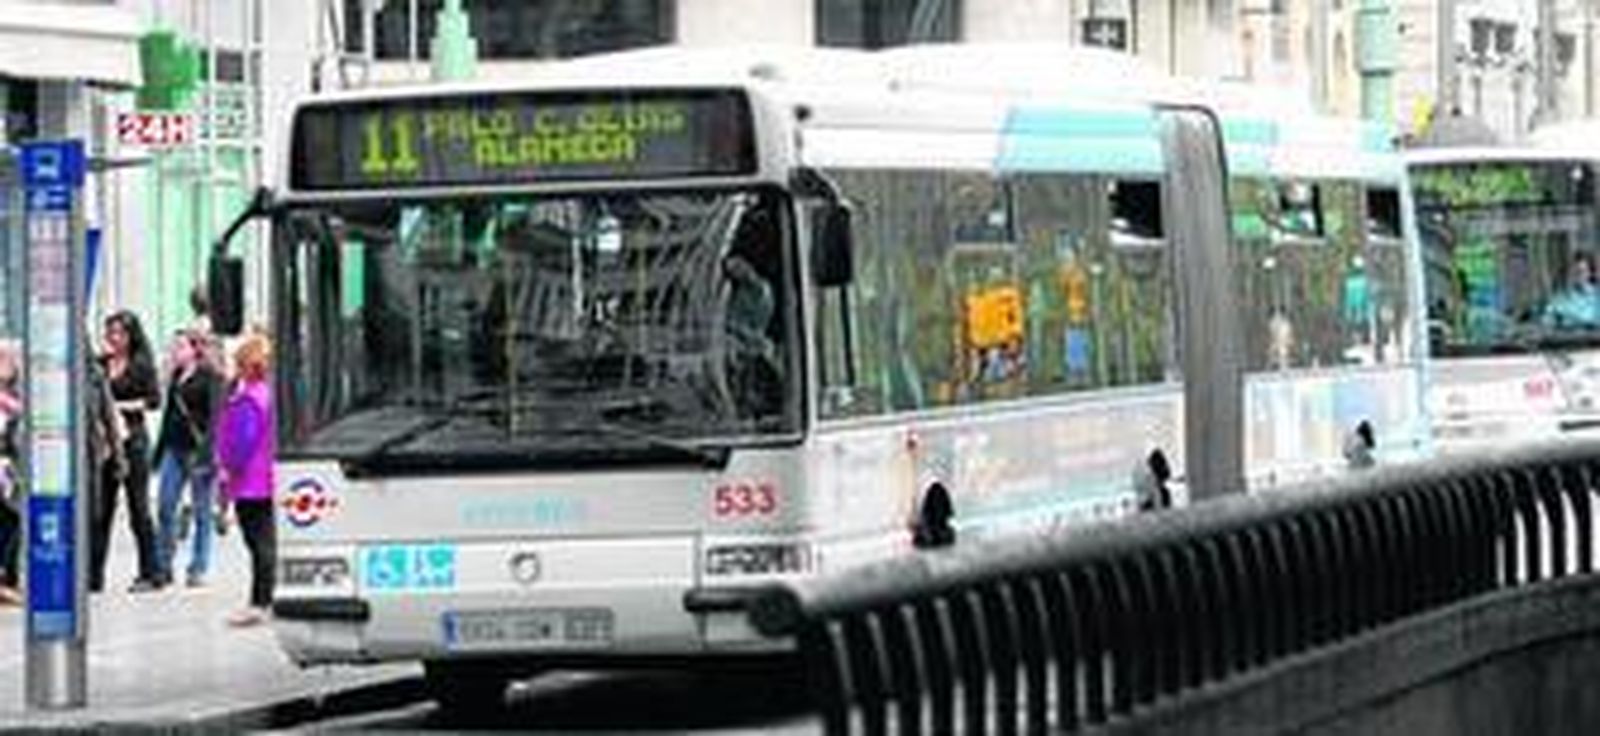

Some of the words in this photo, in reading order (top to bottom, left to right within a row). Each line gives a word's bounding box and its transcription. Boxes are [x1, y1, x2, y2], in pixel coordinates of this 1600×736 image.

[116, 113, 191, 144] 24H
[424, 110, 513, 136] PALO
[361, 113, 418, 171] 11
[715, 483, 777, 515] 533
